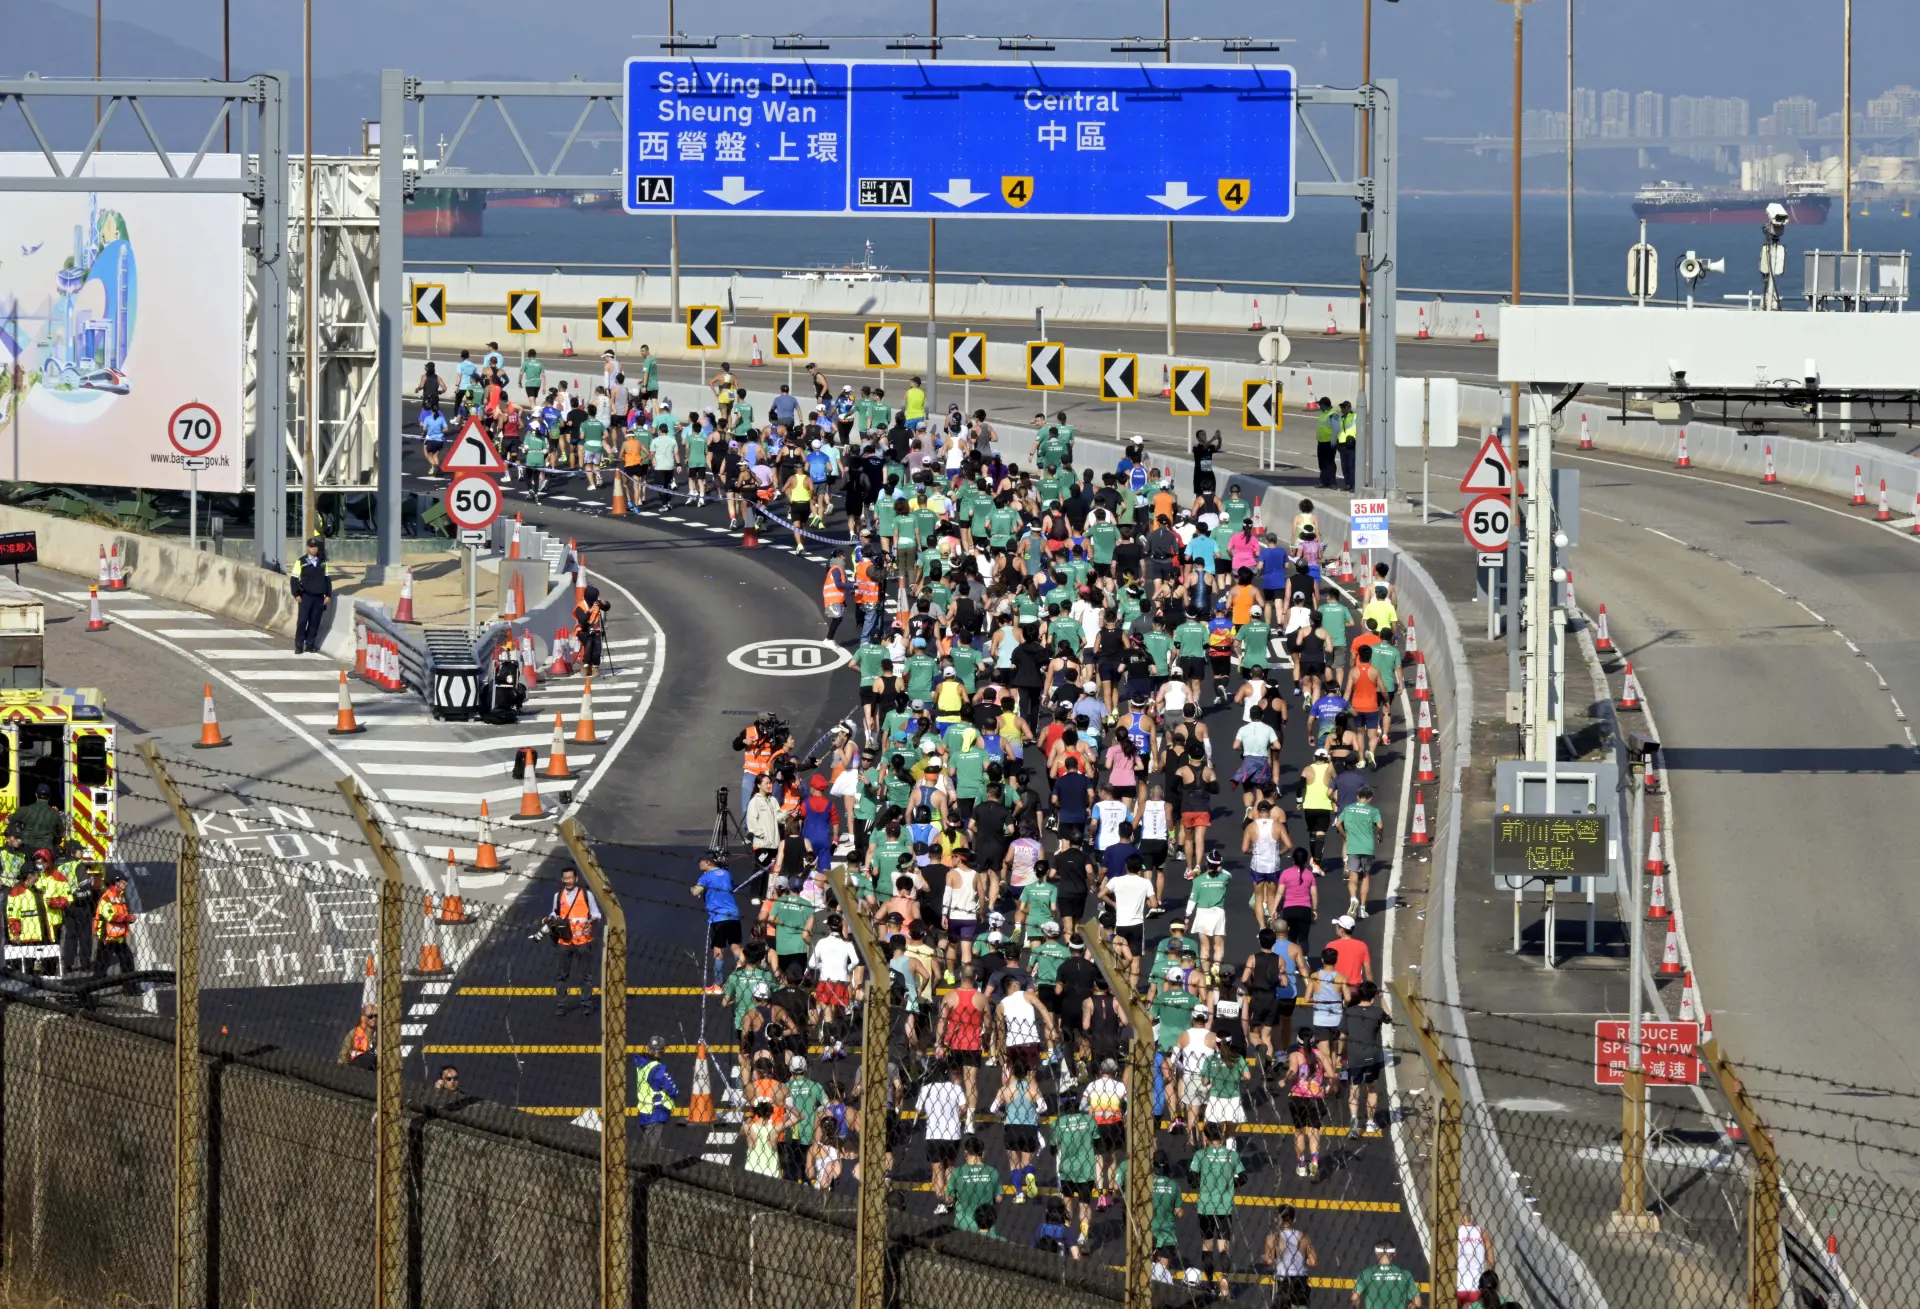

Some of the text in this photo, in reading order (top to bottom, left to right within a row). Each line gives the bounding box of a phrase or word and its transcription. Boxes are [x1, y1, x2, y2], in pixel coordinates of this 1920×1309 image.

[658, 71, 818, 98] Sai Ying Pun
[1023, 89, 1120, 112] Central
[658, 100, 817, 126] Sheung Wan
[1037, 120, 1106, 151] 中區
[640, 178, 670, 201] 1A
[861, 180, 877, 190] EXIT
[879, 181, 908, 203] 1A
[1008, 180, 1027, 201] 4
[1224, 183, 1244, 205] 4
[178, 418, 212, 440] 70
[455, 489, 492, 512] 50
[1354, 503, 1385, 514] 35 KM
[1473, 511, 1509, 534] 50
[757, 647, 822, 668] 50
[1525, 846, 1575, 871] 慢駛
[1617, 1028, 1678, 1040] RDUCE
[1603, 1042, 1692, 1055] SPED NOW
[1609, 1060, 1686, 1079] 開減速
